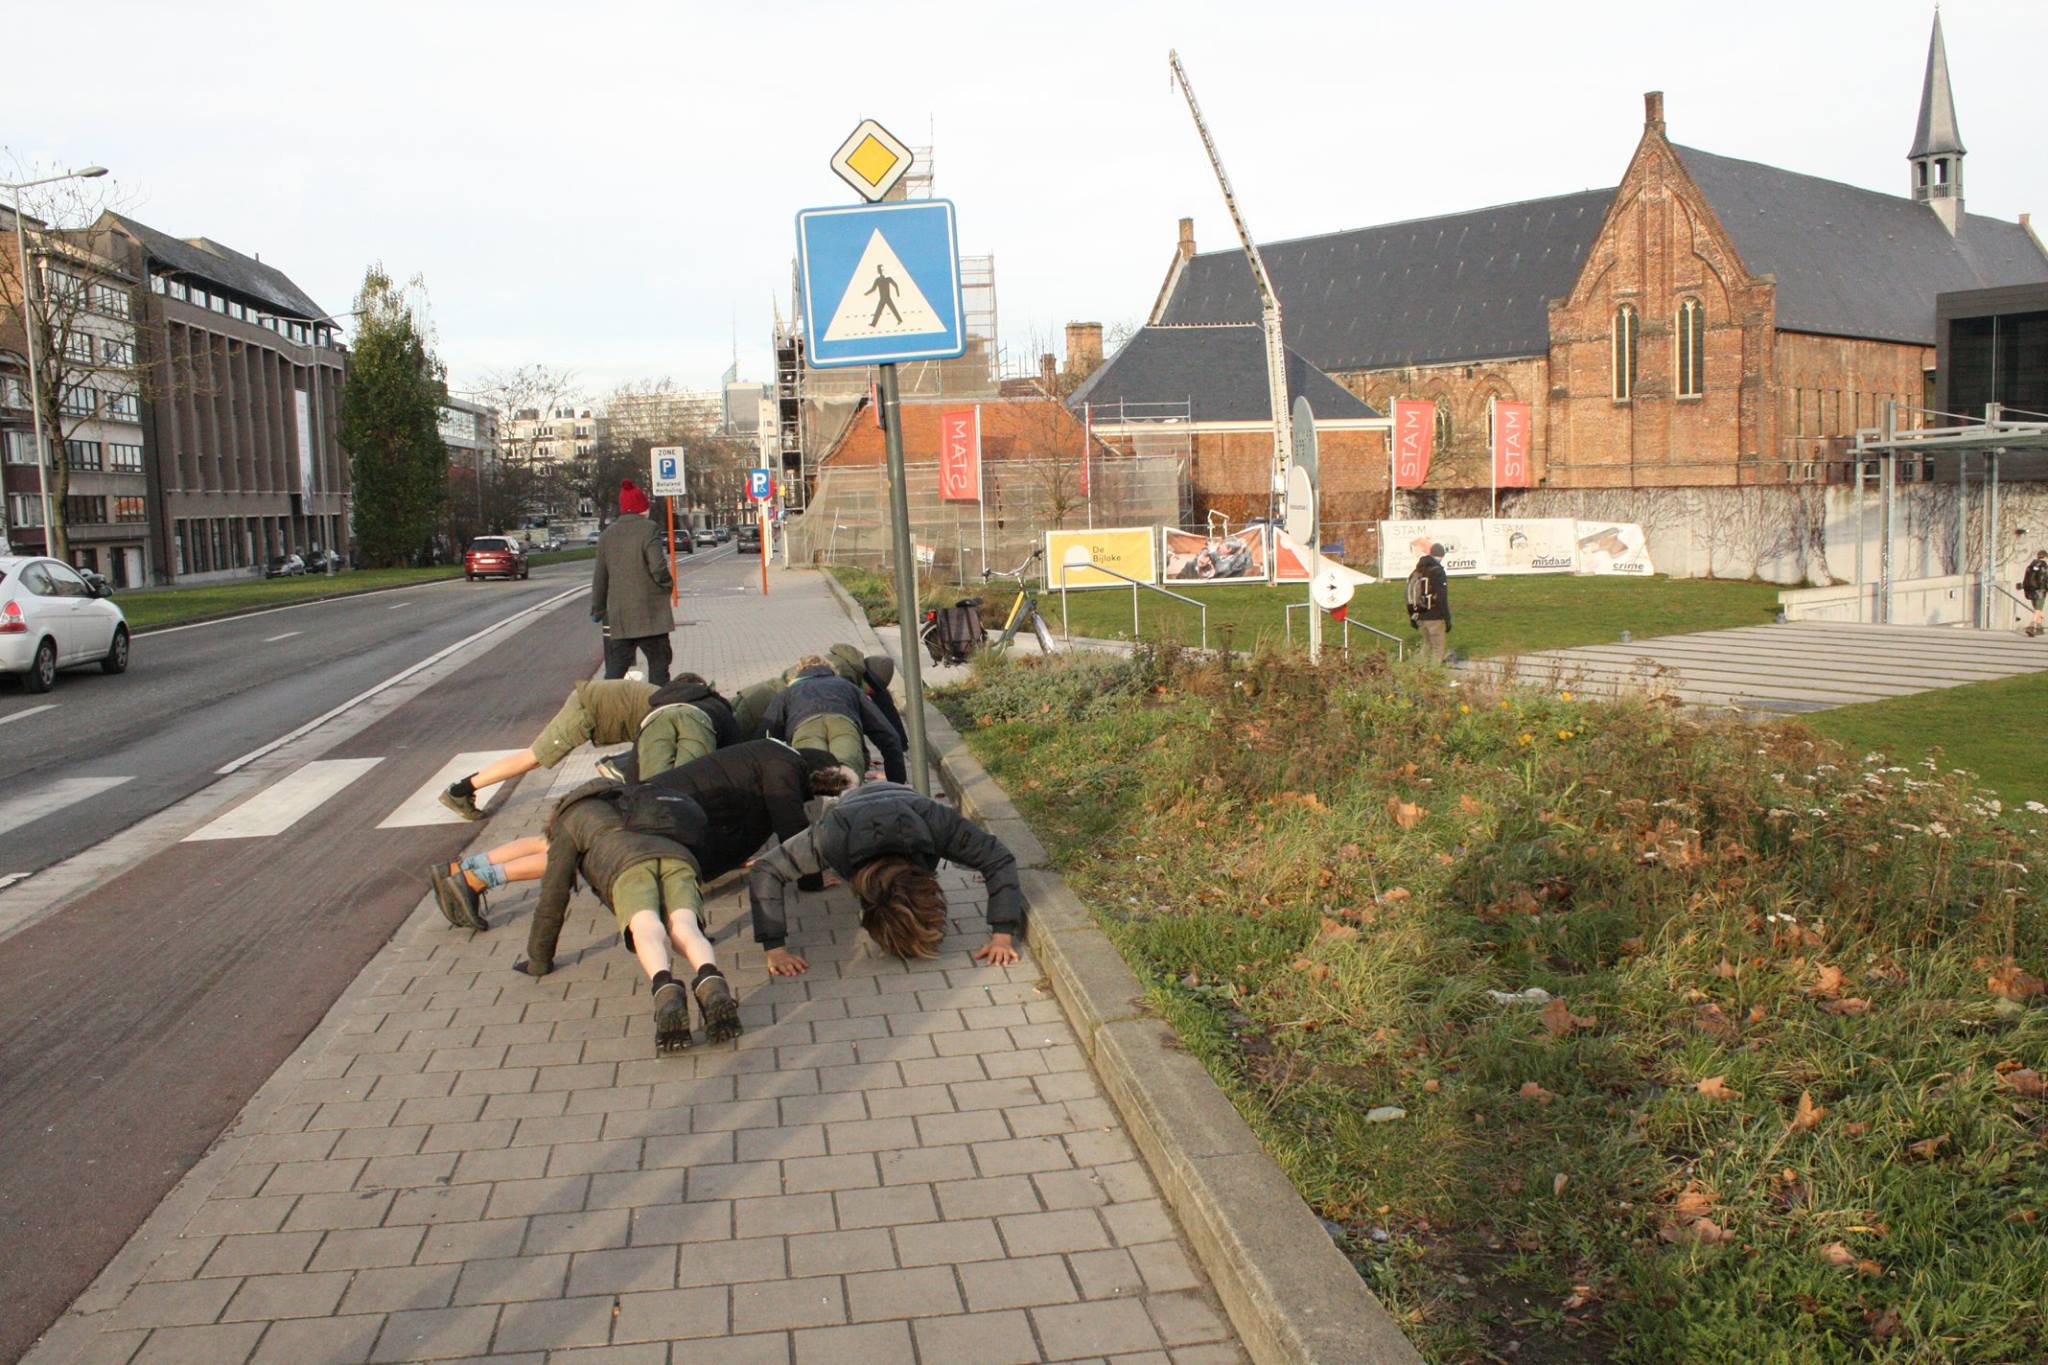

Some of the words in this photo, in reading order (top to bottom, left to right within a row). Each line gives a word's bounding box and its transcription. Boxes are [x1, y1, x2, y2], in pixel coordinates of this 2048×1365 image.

[662, 460, 672, 473] P
[752, 472, 767, 493] P
[1092, 546, 1105, 554] De
[1092, 554, 1122, 564] Bijloke
[1446, 557, 1477, 568] crime
[1531, 556, 1572, 567] misdaad
[1612, 561, 1645, 571] crime
